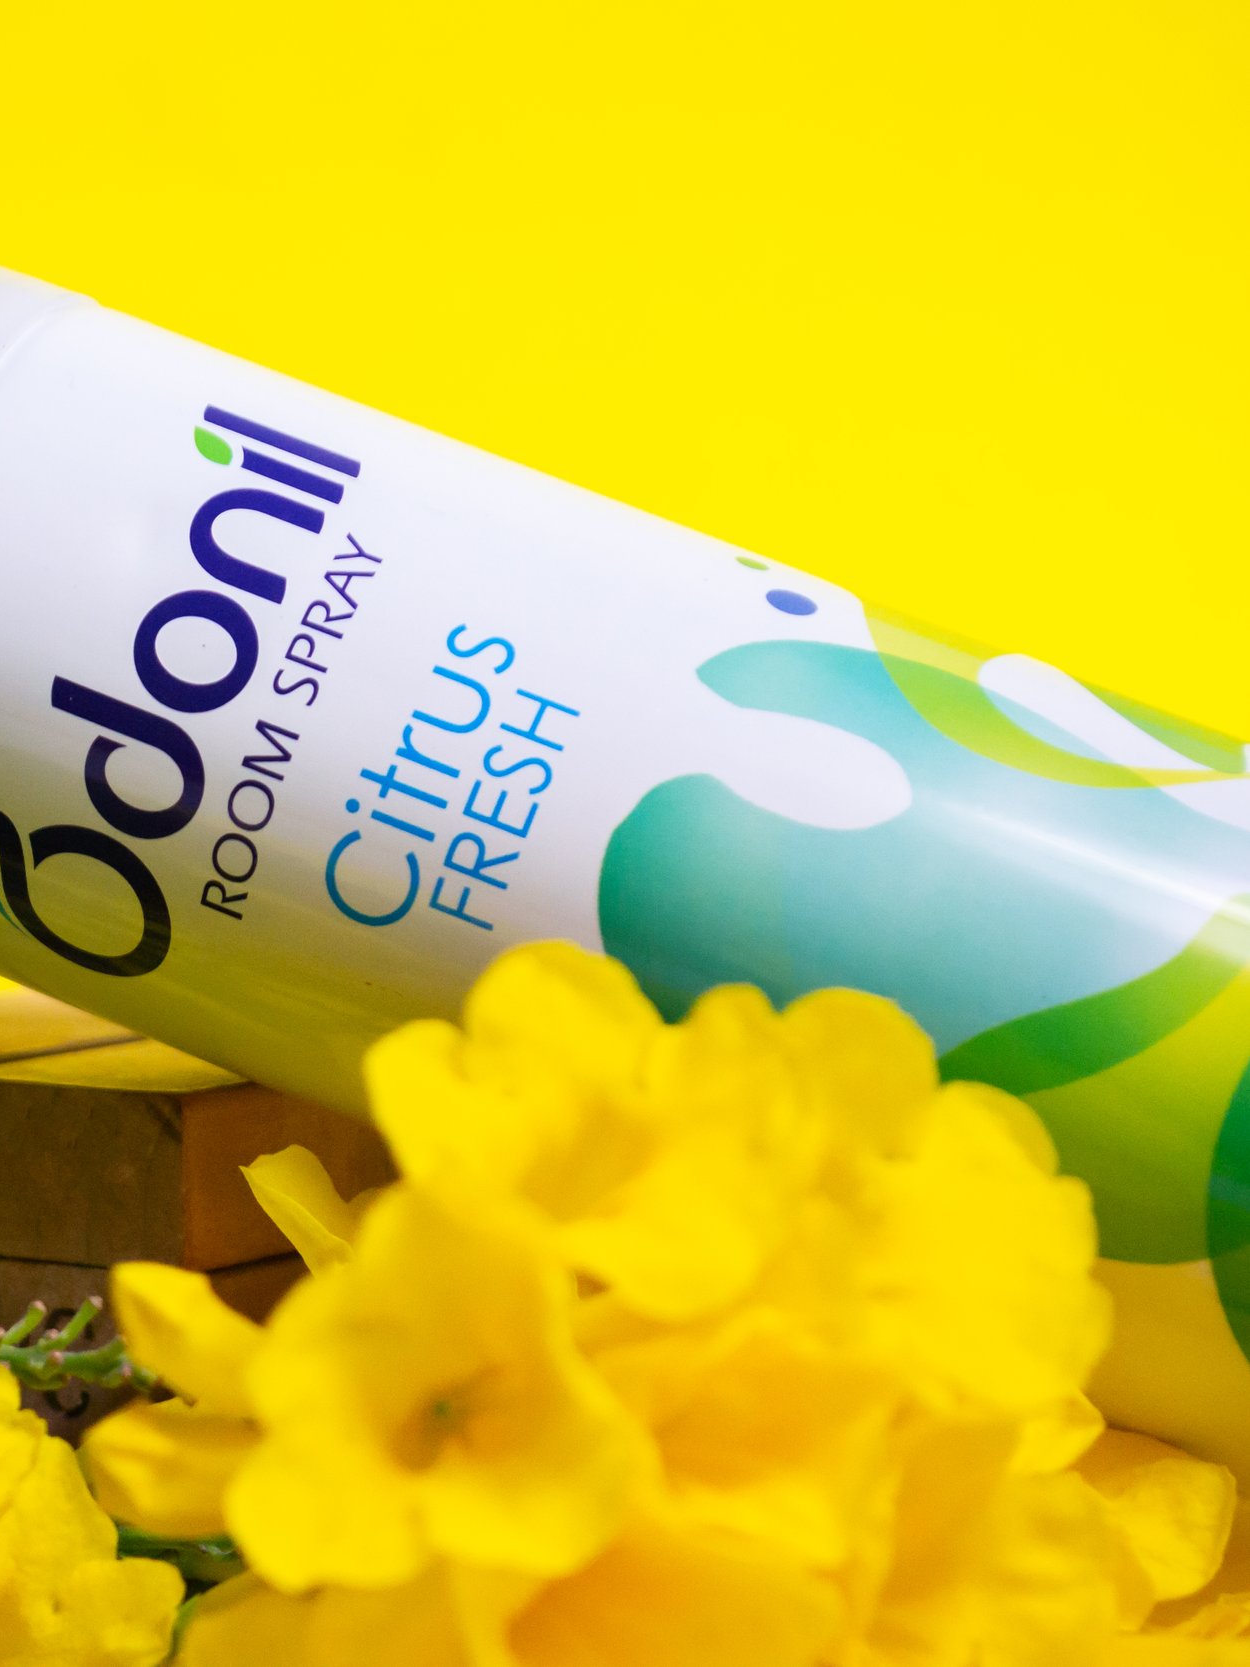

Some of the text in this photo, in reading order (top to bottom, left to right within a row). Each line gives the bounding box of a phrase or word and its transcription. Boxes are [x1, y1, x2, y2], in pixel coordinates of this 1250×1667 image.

[200, 533, 384, 920] ROOM SPRAY
[325, 623, 516, 927] Citrus
[429, 688, 580, 931] FRESH
